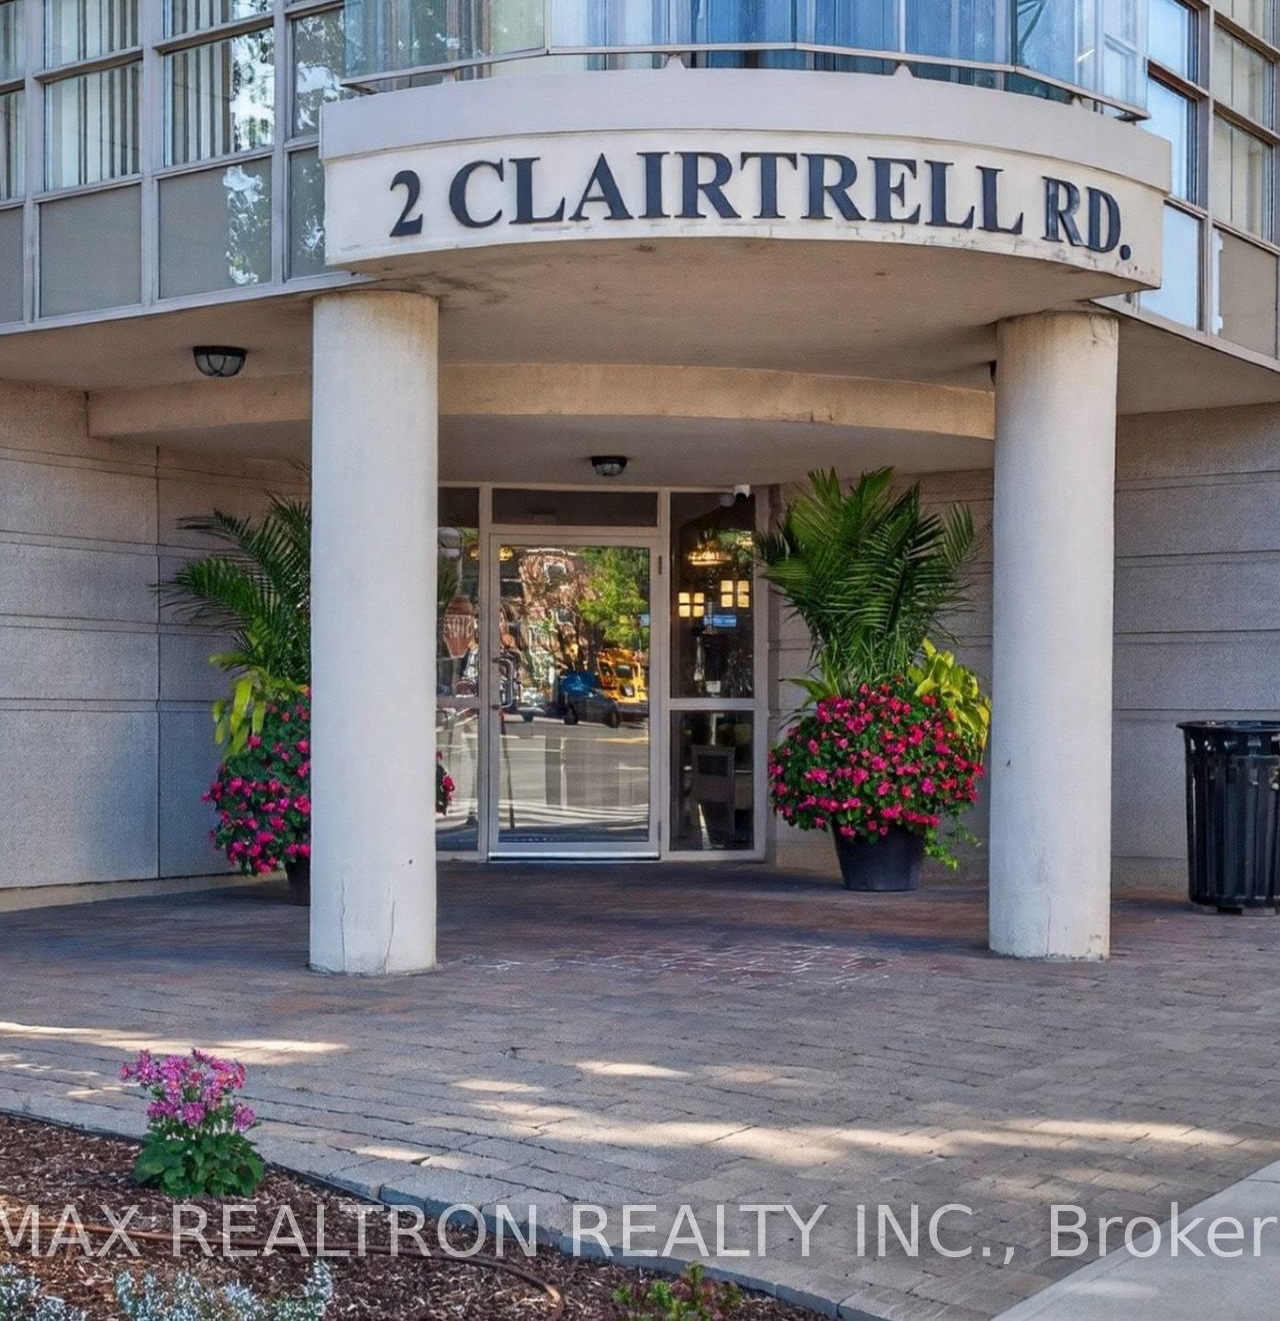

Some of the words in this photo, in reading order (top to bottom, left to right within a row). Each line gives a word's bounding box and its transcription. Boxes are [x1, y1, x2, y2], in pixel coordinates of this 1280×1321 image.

[388, 170, 423, 237] 2
[448, 151, 1023, 235] CLAIRTRELL
[1042, 176, 1131, 260] RD.
